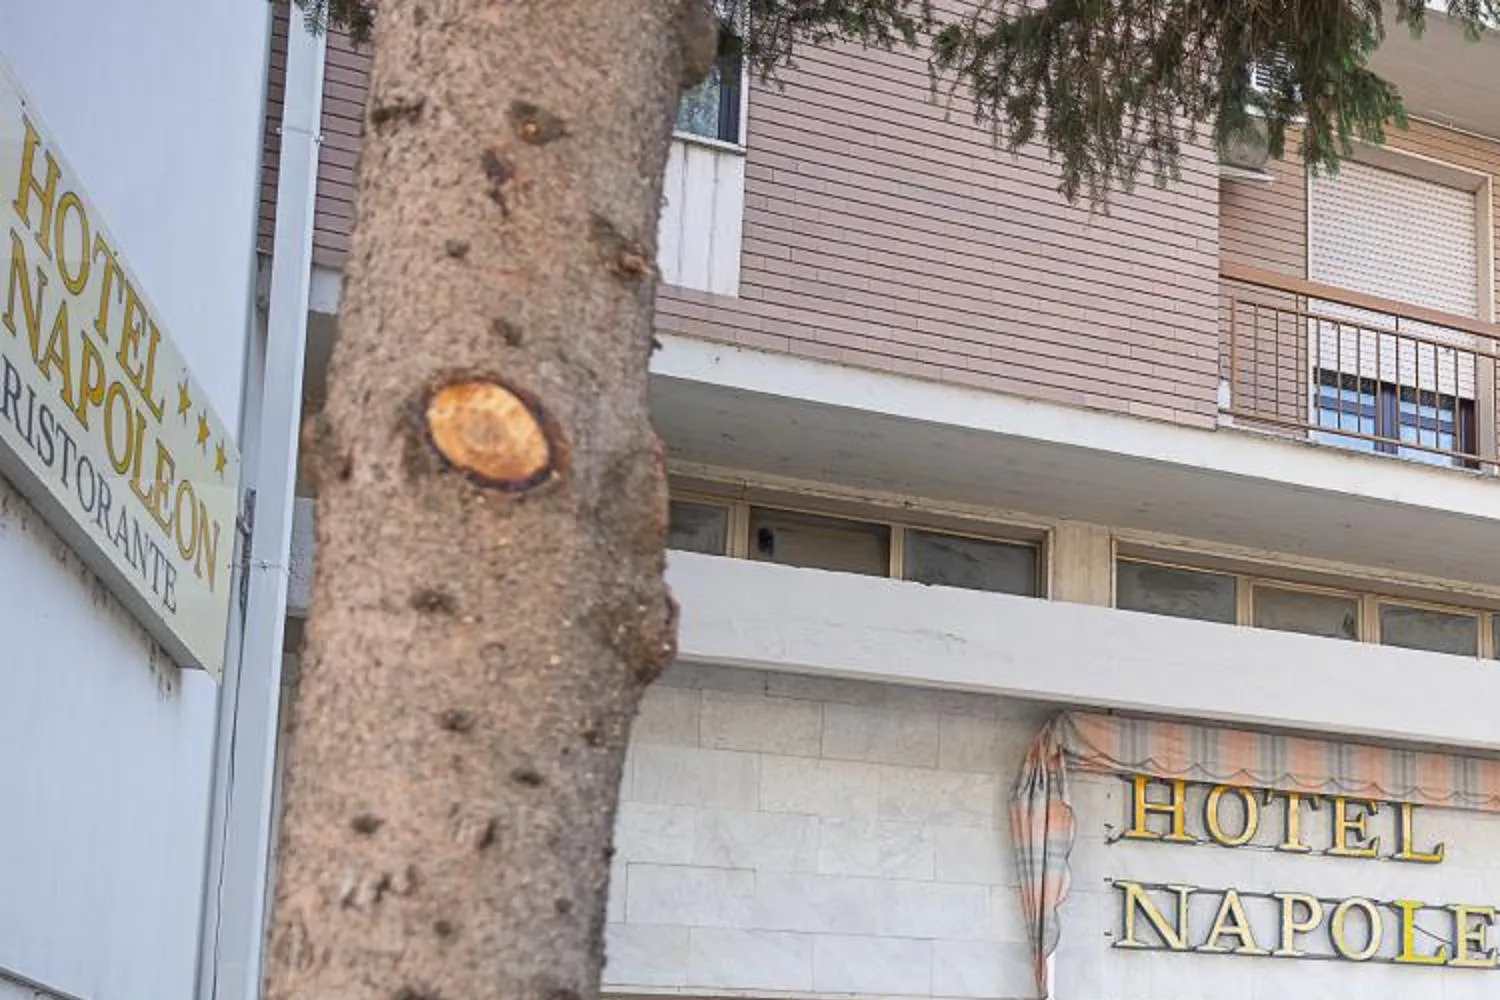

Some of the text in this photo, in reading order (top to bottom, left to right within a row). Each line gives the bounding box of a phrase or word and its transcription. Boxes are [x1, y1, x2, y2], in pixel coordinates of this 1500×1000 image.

[2, 228, 221, 592] NAPOLEON
[13, 114, 165, 424] HOTEL
[0, 353, 178, 615] RISTORANTE
[1118, 772, 1445, 863] HOTEL
